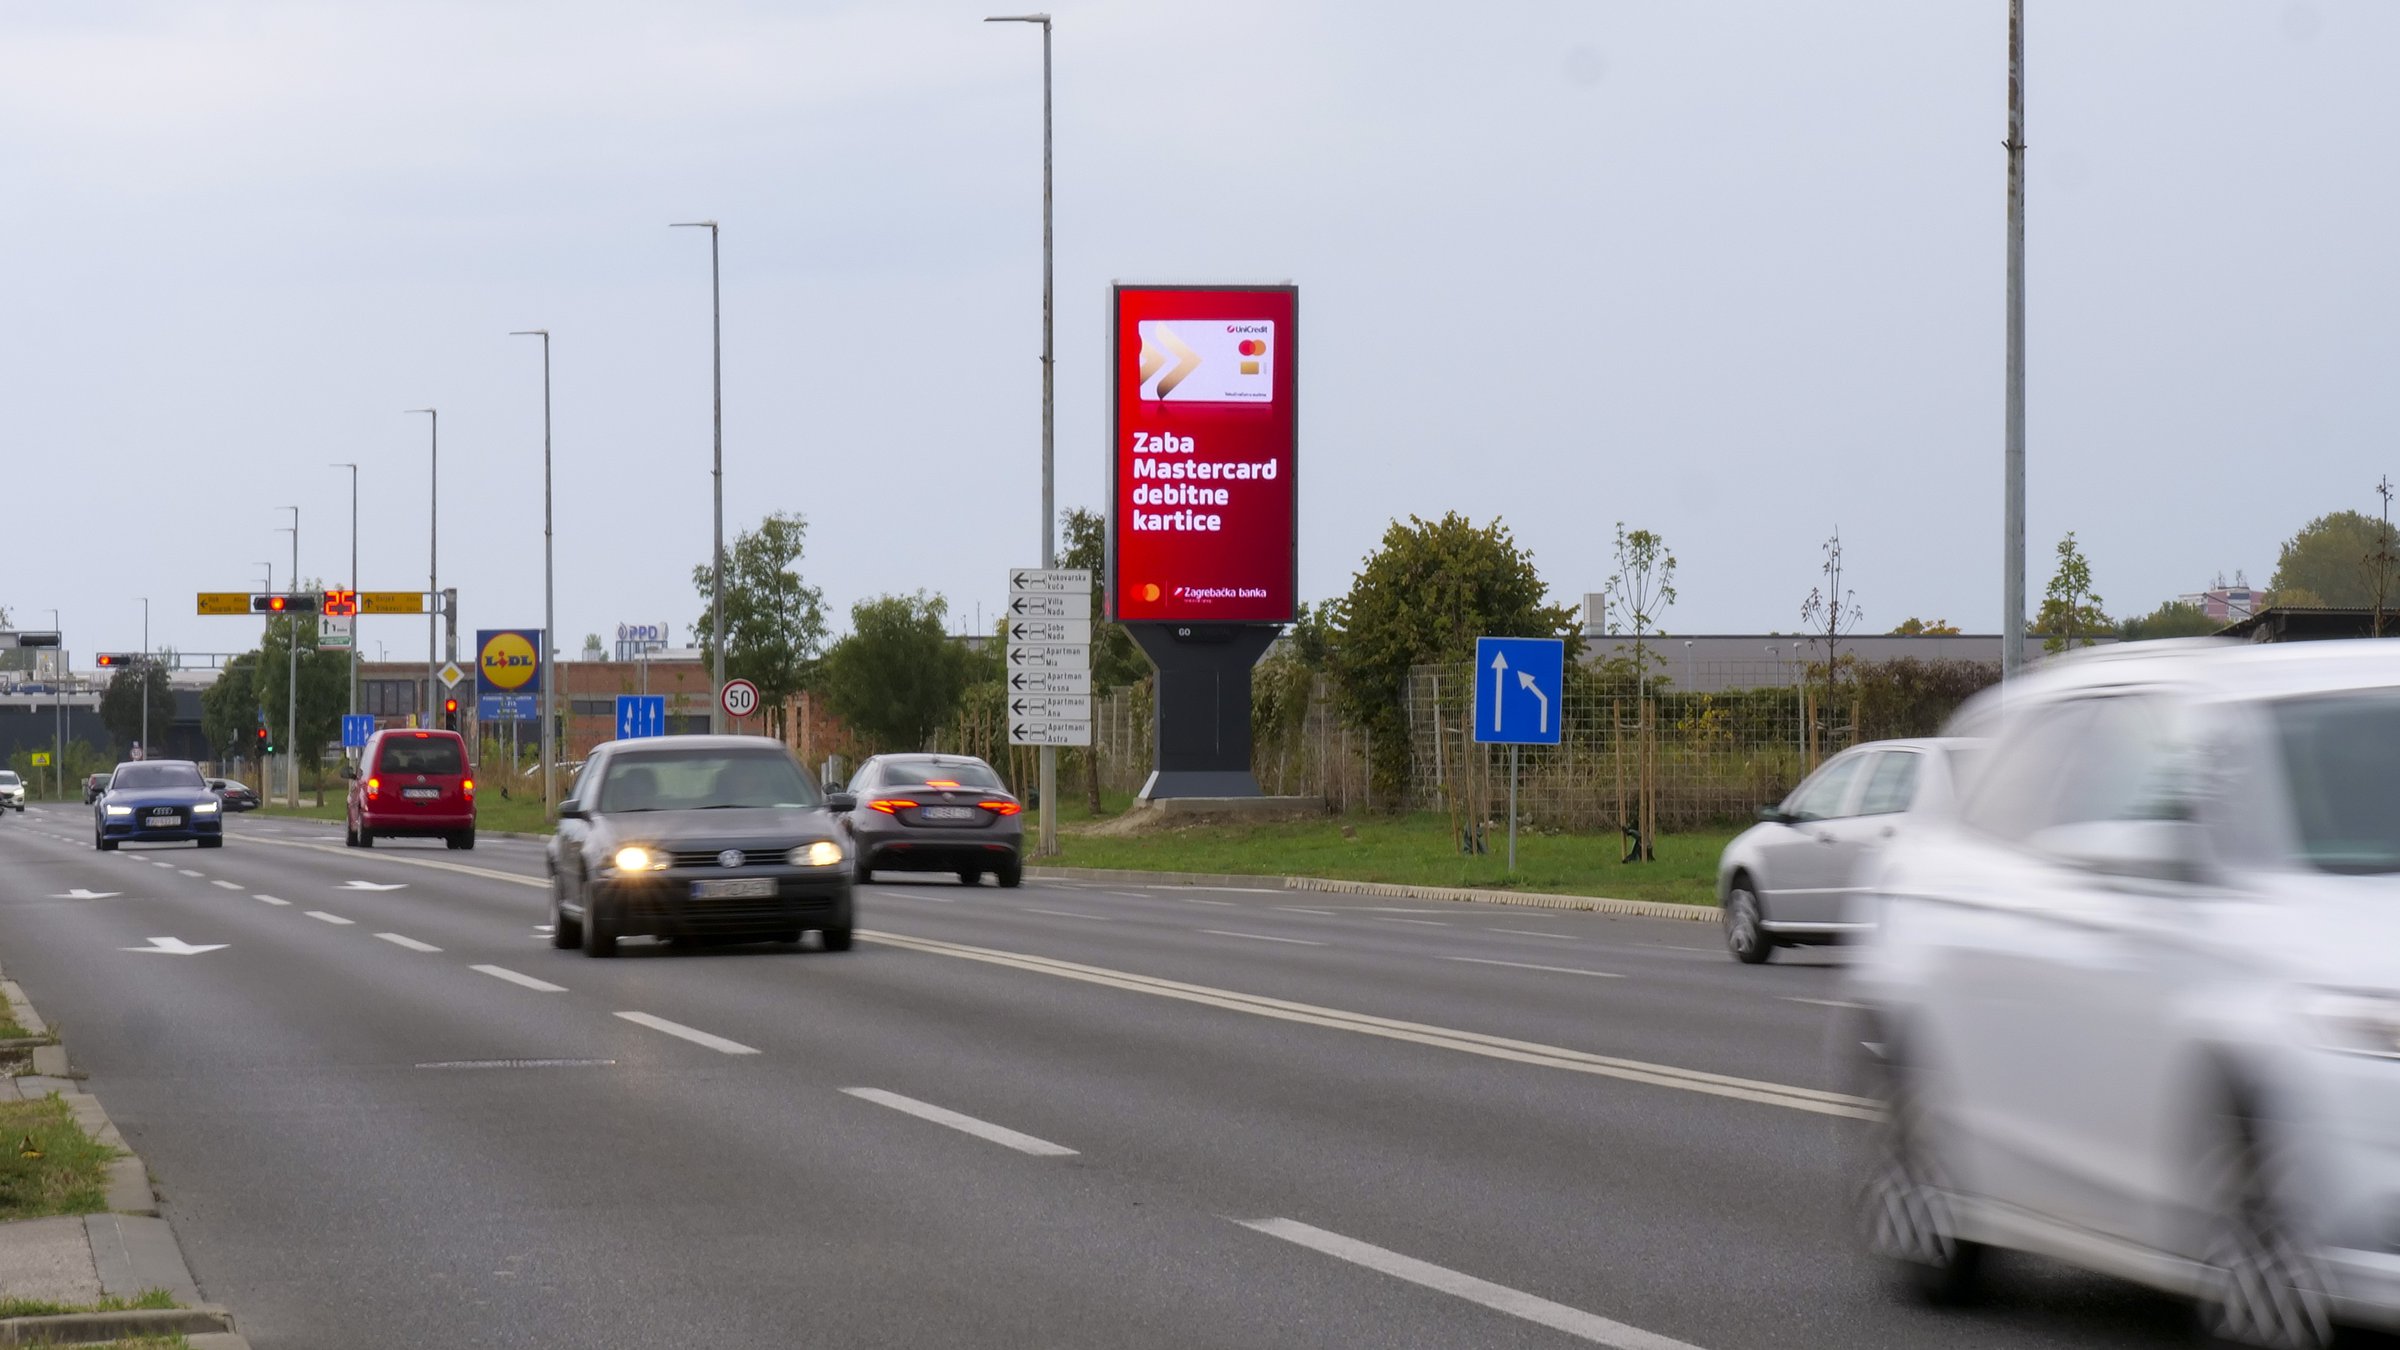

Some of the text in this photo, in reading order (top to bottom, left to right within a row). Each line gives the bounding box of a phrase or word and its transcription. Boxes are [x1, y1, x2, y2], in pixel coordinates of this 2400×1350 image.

[1235, 325, 1268, 334] UniCredit
[1133, 432, 1194, 453] Zaba
[1133, 458, 1277, 480] Mastercard
[1133, 483, 1229, 505] debitne
[1133, 509, 1221, 531] kartice
[1184, 587, 1267, 599] Zagrebačka banka
[325, 591, 356, 616] 25
[1048, 597, 1063, 605] Villa
[1048, 607, 1064, 616] Nada
[629, 625, 658, 640] PPD
[1048, 632, 1064, 640] Nada
[1046, 647, 1081, 656] Apartman
[1047, 672, 1082, 681] Apartman
[730, 690, 750, 708] 50
[1047, 697, 1085, 706] Apartmani
[1048, 723, 1085, 732] Apartmani
[1048, 735, 1068, 743] Astra
